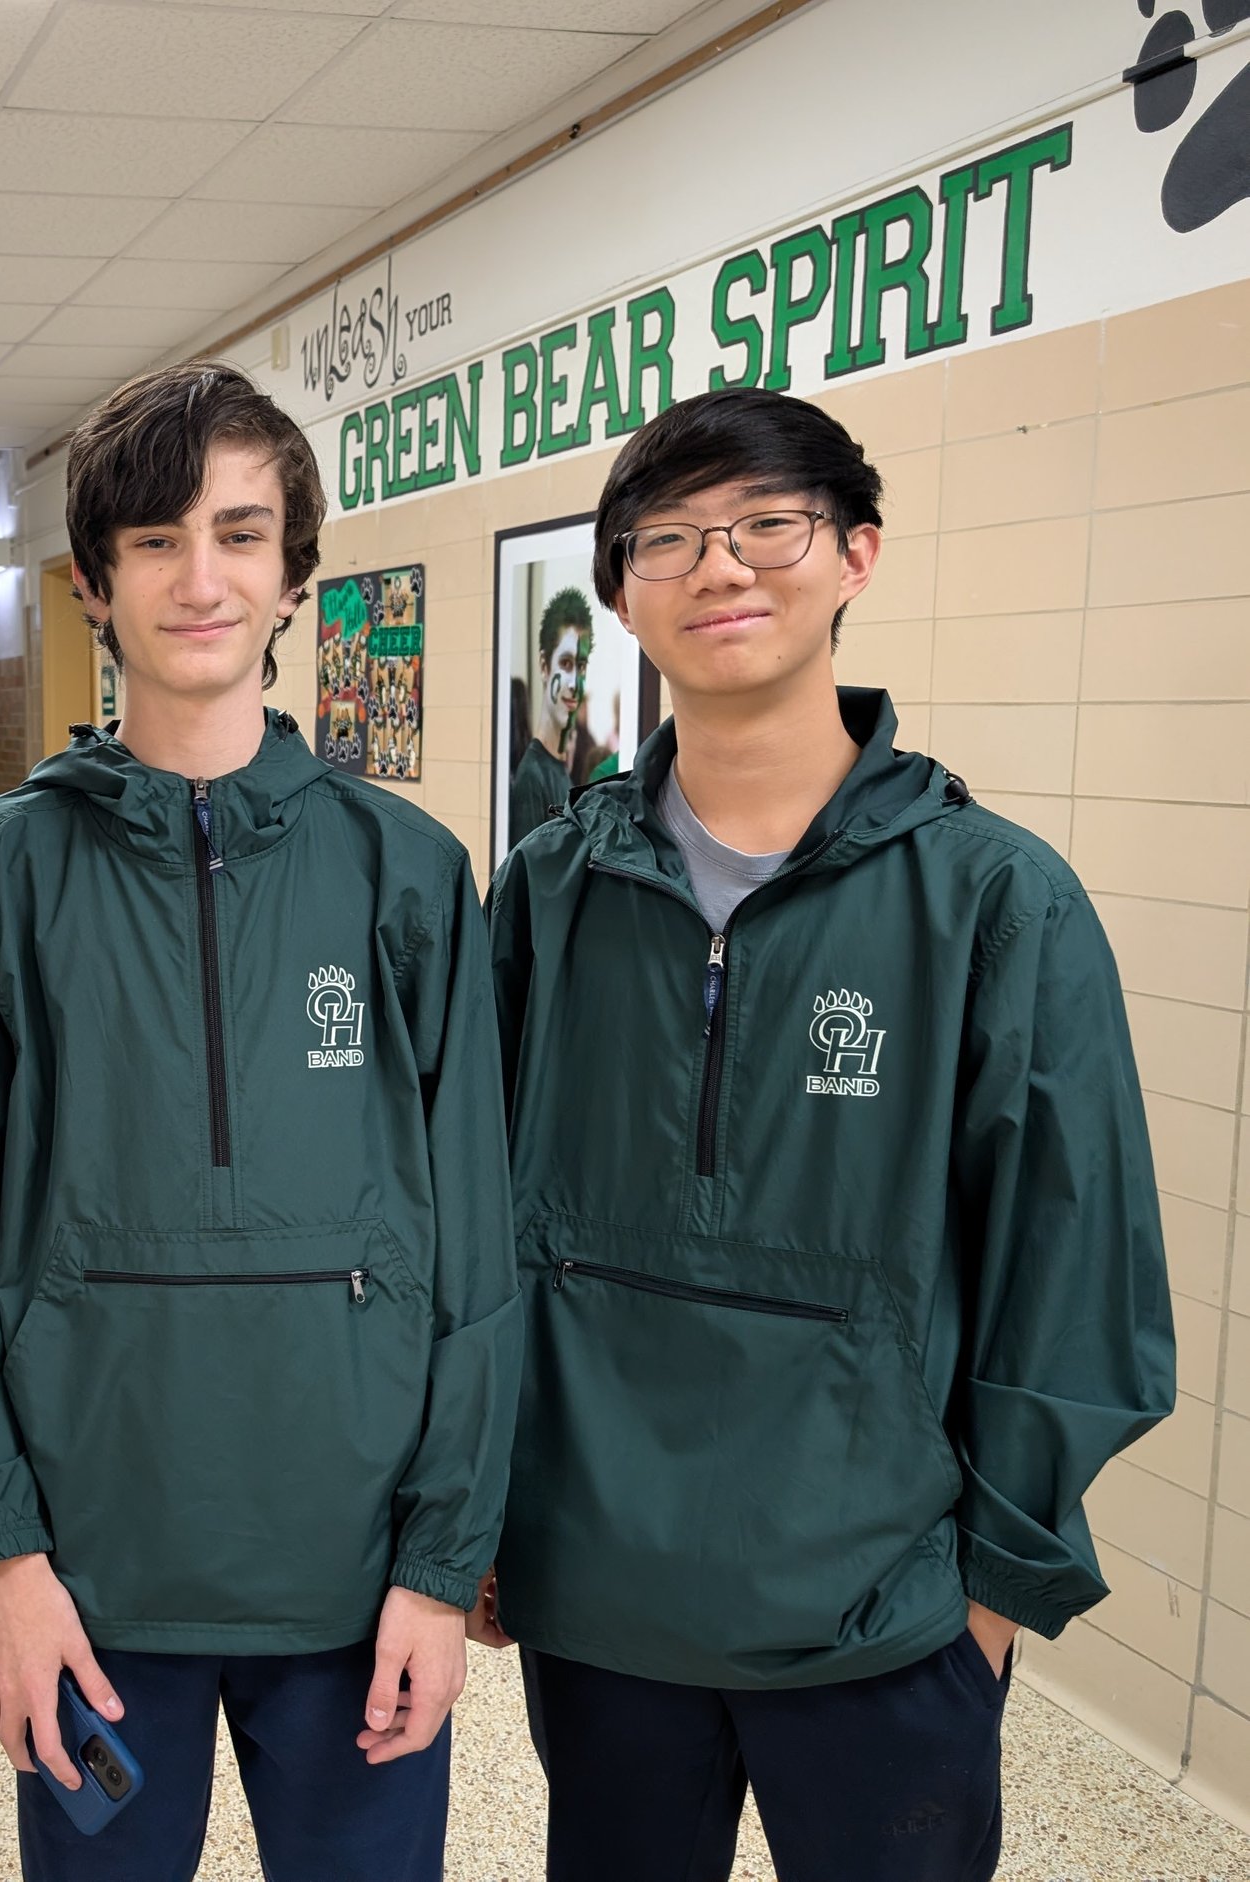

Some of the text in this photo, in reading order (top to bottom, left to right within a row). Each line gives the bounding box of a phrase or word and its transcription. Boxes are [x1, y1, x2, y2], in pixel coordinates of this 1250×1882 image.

[338, 122, 1073, 511] GREEN BEAR SPIRIT
[405, 293, 452, 342] YOUR
[368, 625, 422, 657] CHEER
[306, 982, 366, 1047] OH
[307, 1048, 365, 1069] BAND
[809, 1006, 887, 1075] OH
[805, 1075, 880, 1097] BAND
